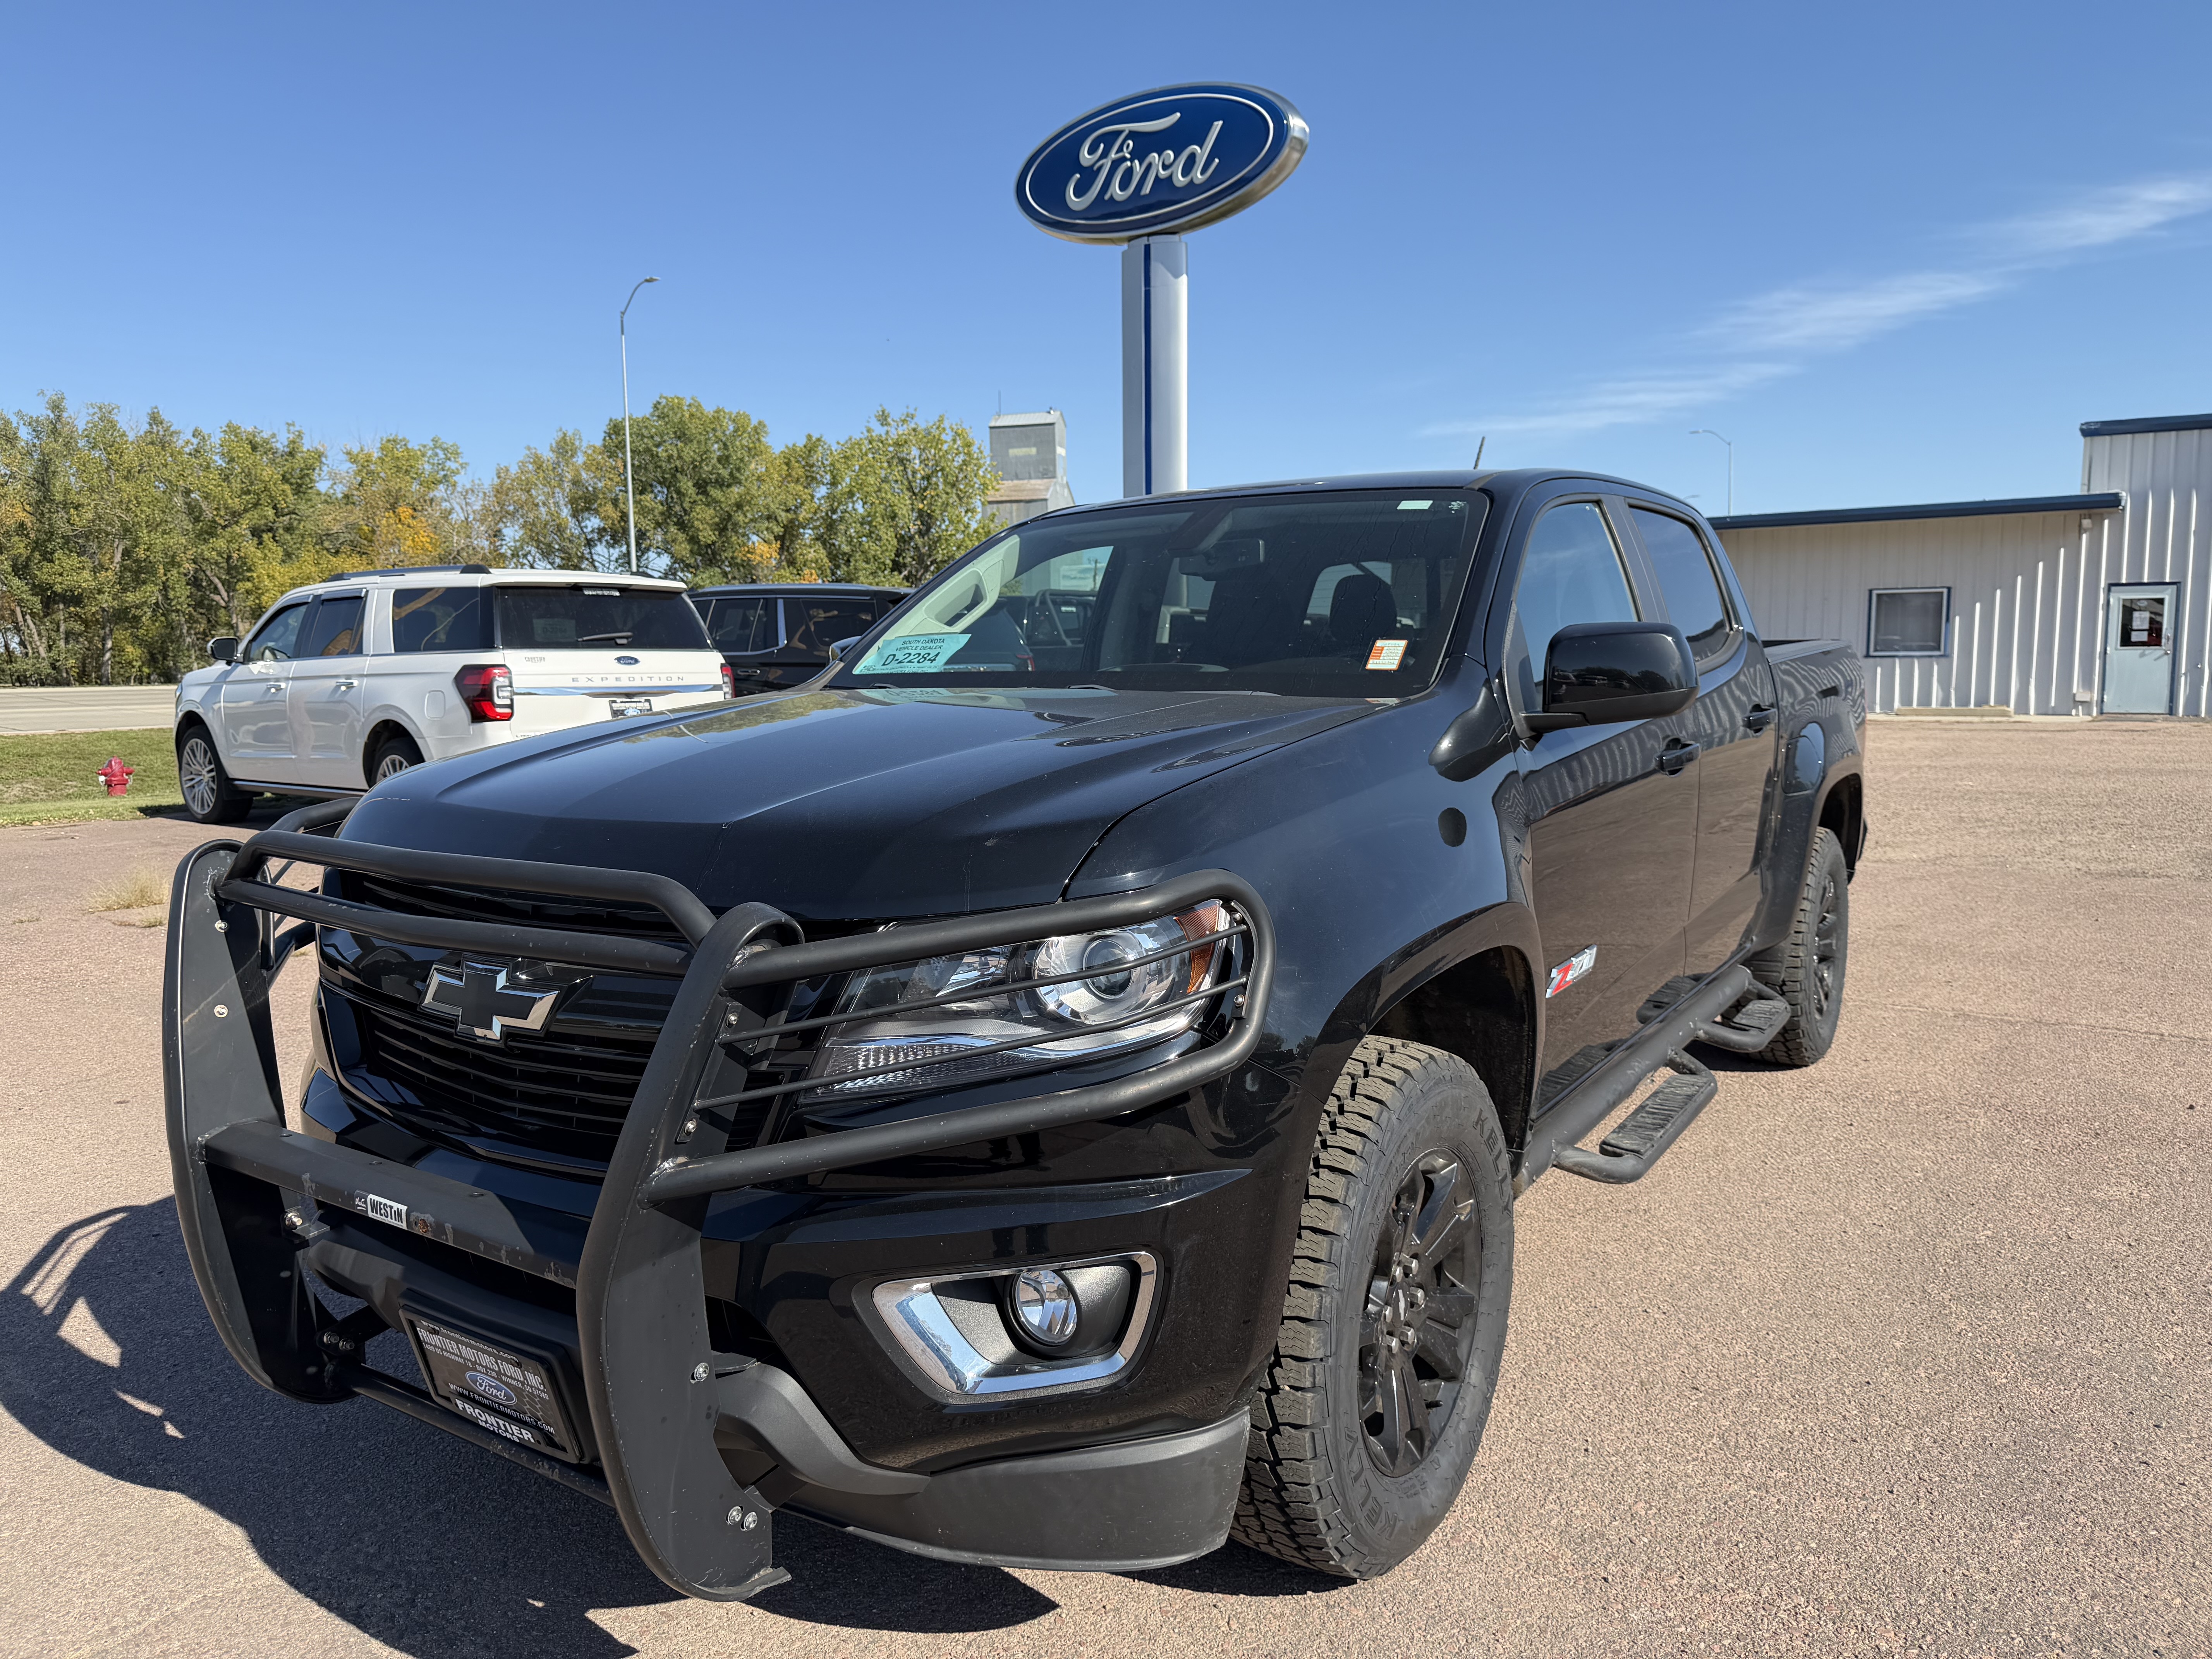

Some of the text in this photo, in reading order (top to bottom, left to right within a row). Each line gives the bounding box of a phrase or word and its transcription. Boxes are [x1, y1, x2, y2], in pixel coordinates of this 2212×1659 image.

[1065, 112, 1223, 211] Ford
[881, 651, 941, 666] D-2284
[1546, 944, 1597, 998] Z71
[1472, 1108, 1513, 1218] KELLY
[416, 1327, 460, 1355] FRONTIER
[458, 1344, 499, 1371] MOTORS
[421, 1320, 519, 1362] www.frontiermotors.com
[443, 1350, 464, 1364] HIGHWAY
[476, 1364, 487, 1374] BOX
[448, 1382, 555, 1434] WWW.FRONTIERMOTORS.COM
[477, 1376, 507, 1401] Ford
[455, 1398, 535, 1443] FRONTIER
[477, 1419, 520, 1443] MOTORS
[1344, 1426, 1398, 1541] KELLY
